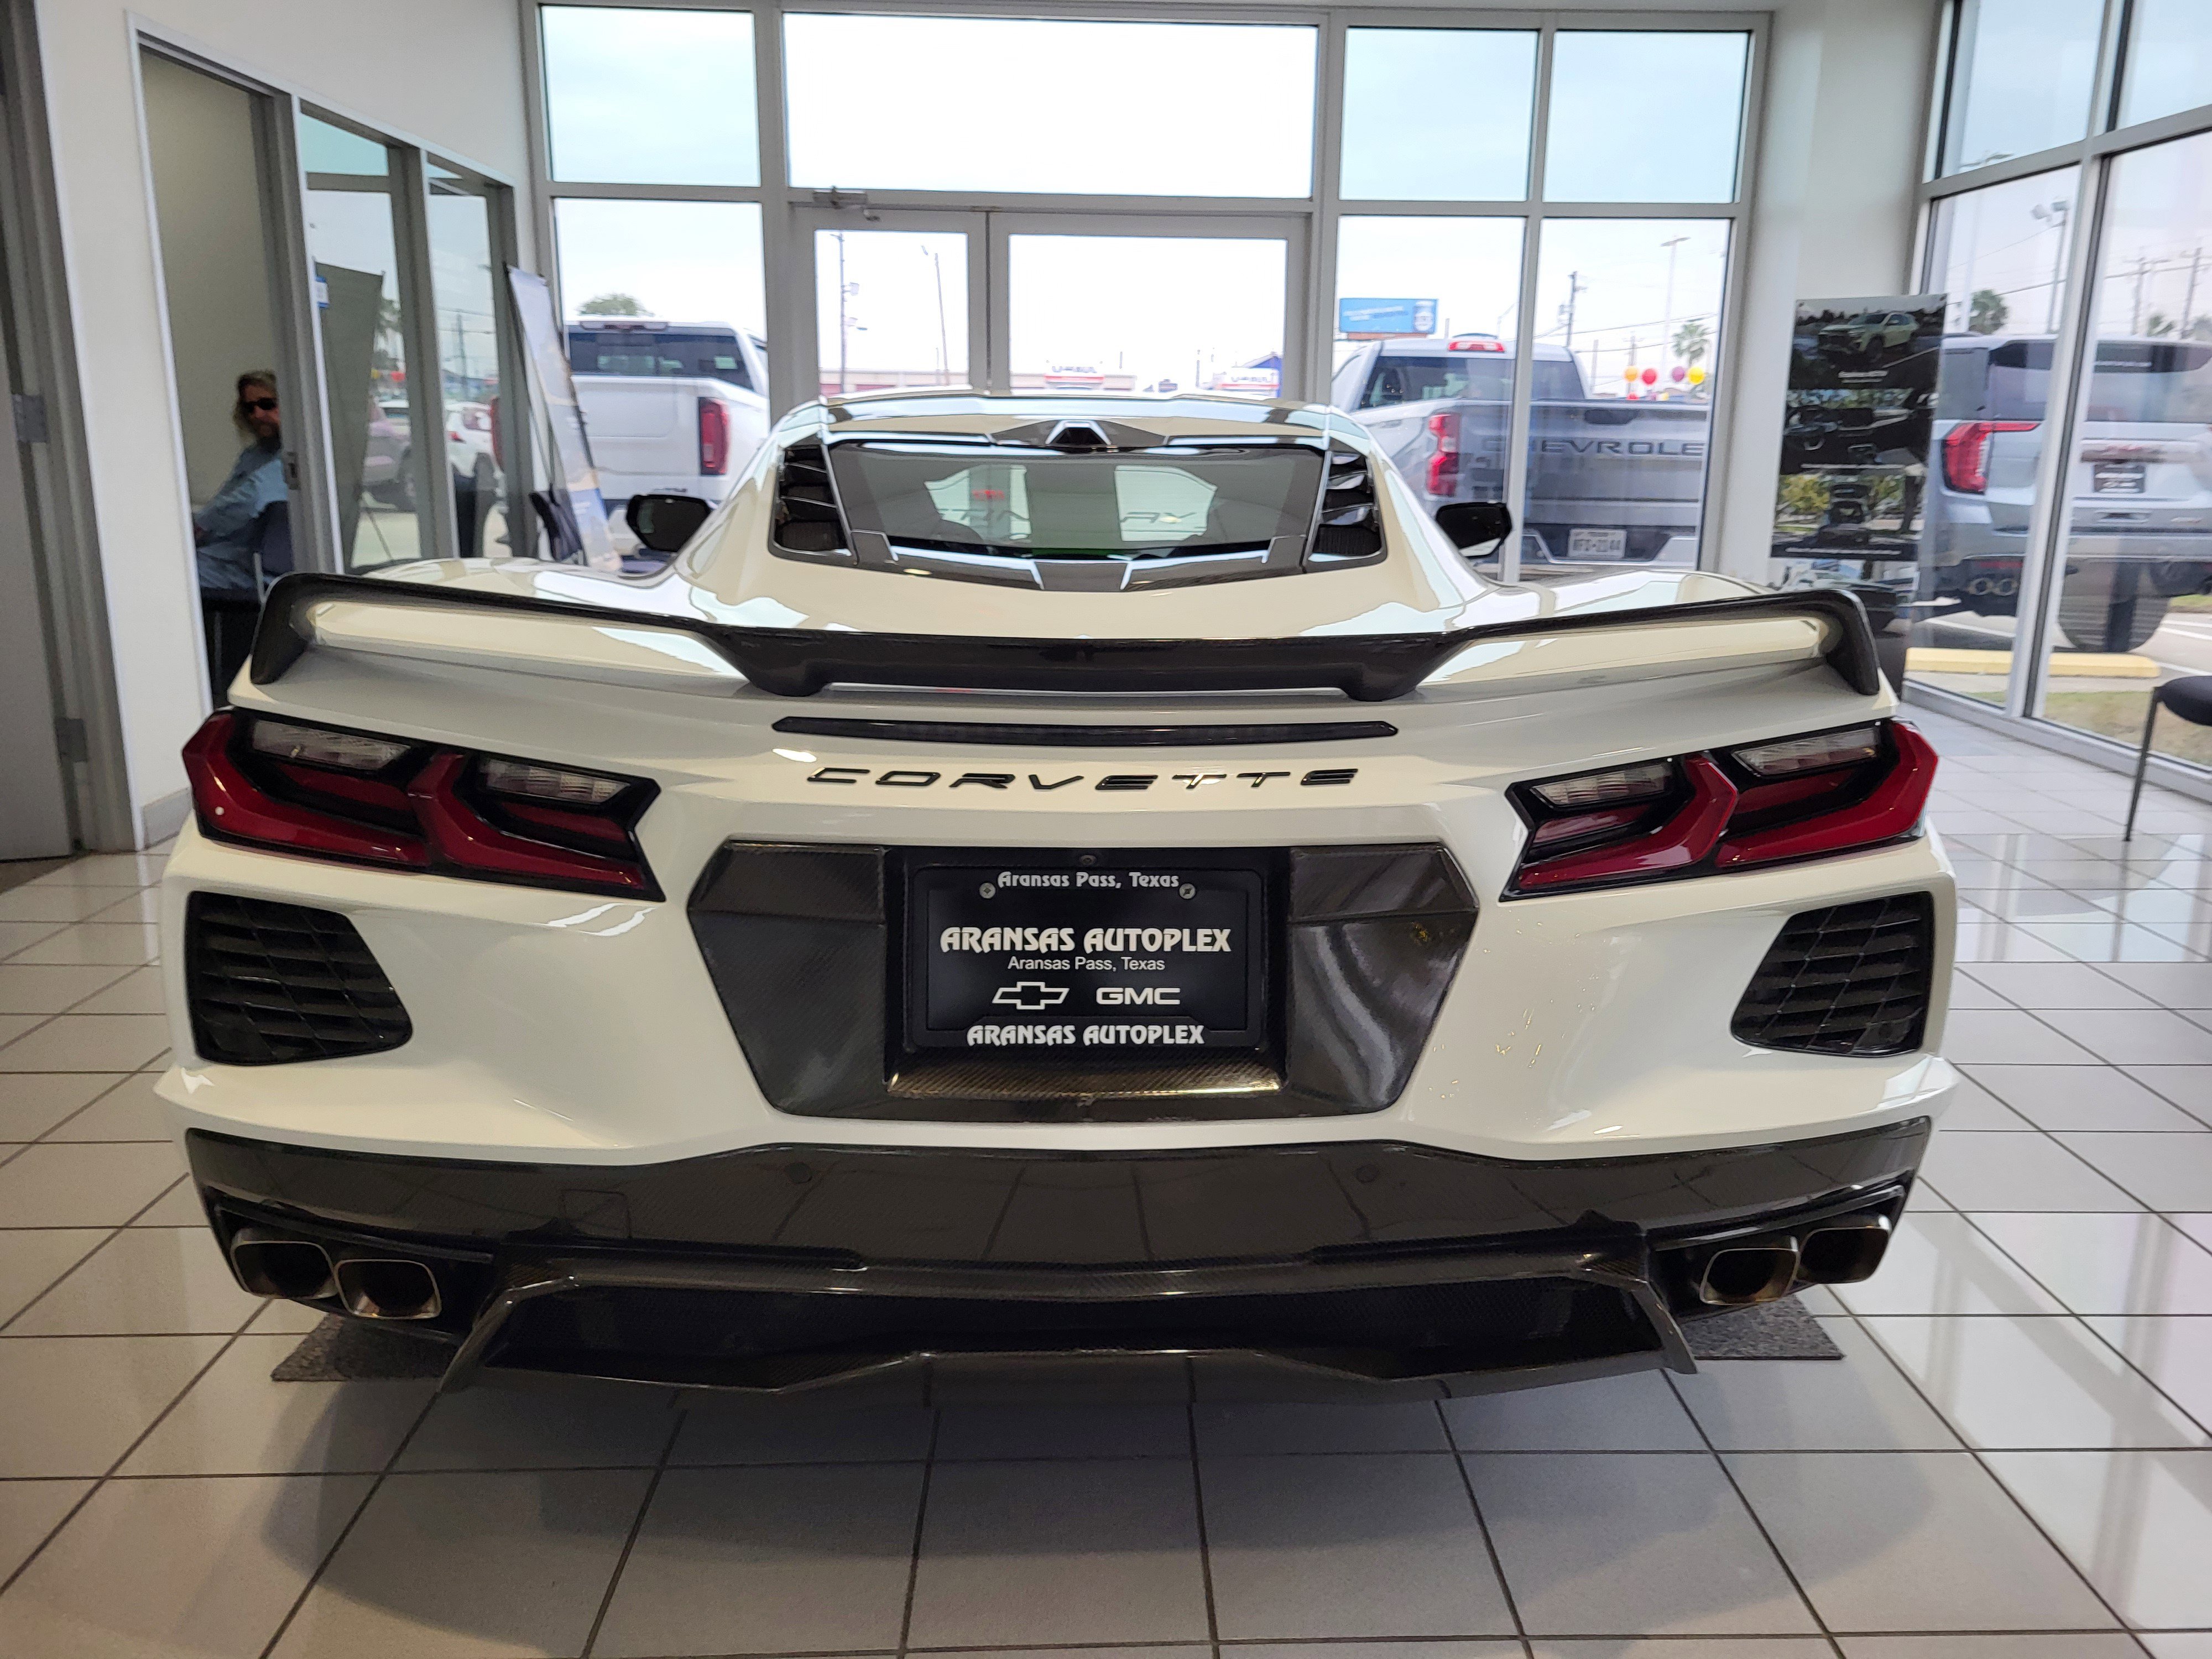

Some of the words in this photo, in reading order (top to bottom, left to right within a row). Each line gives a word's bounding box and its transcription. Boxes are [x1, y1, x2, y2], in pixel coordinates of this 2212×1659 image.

[1482, 437, 1705, 456] CEVROLE
[807, 768, 1358, 791] CORVETTE
[998, 871, 1070, 888] Aransas
[1076, 872, 1121, 889] Pass,
[1128, 872, 1179, 887] Texas
[940, 927, 1075, 954] ARANSAS
[1083, 927, 1232, 954] AUTOPLEX
[1007, 956, 1071, 971] Aransas
[1074, 956, 1117, 972] Pass,
[1120, 956, 1166, 971] Texas
[1095, 987, 1181, 1005] GMC
[967, 1025, 1076, 1046] ARANSAS
[1083, 1025, 1205, 1046] AUTOPLEX
